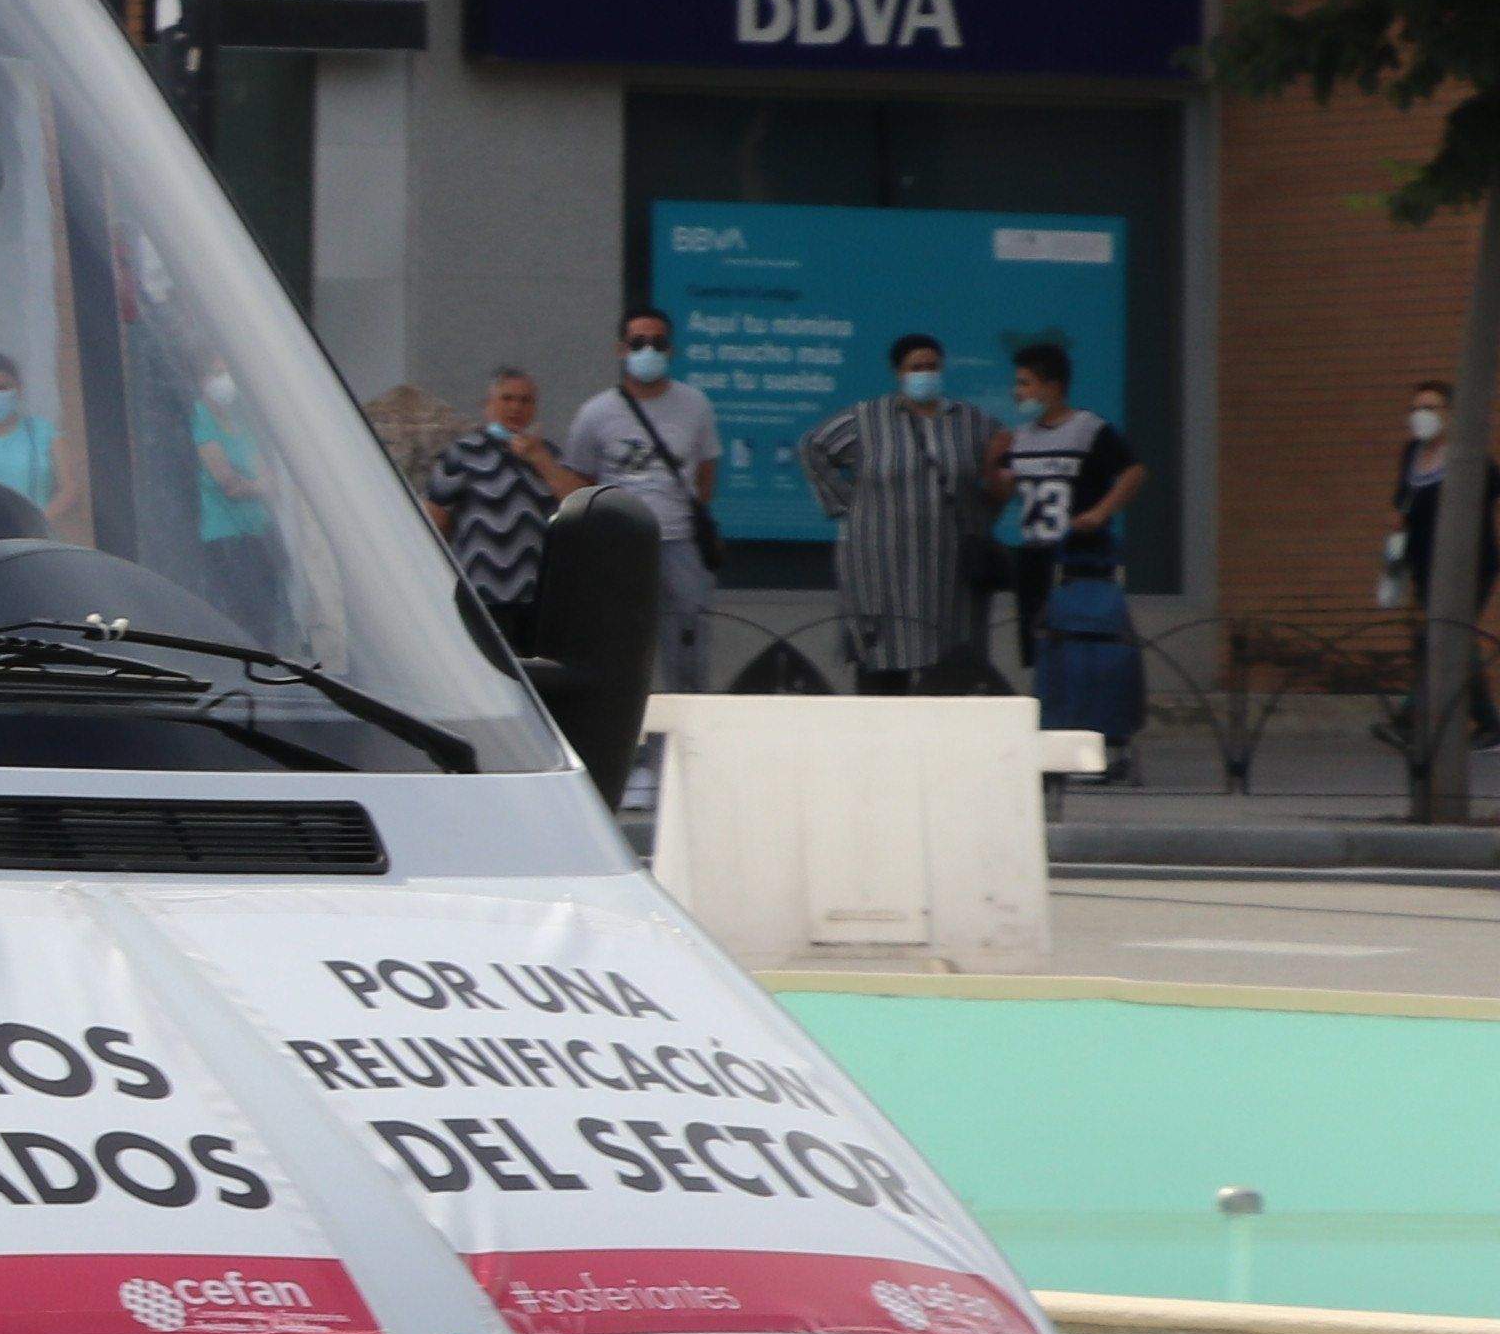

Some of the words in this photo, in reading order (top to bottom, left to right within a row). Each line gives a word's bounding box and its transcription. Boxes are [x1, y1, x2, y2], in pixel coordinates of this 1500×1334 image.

[671, 224, 746, 253] BBVA
[718, 341, 793, 364] mucho
[322, 958, 503, 1011] POR
[502, 961, 677, 1022] UNA
[286, 1037, 836, 1117] REUNIFICACIÓN
[370, 1116, 584, 1193] DEL
[575, 1116, 949, 1224] SECTOR
[172, 1271, 313, 1308] cefan
[509, 1271, 742, 1316] #sosferiantes
[908, 1281, 1000, 1324] cefan
